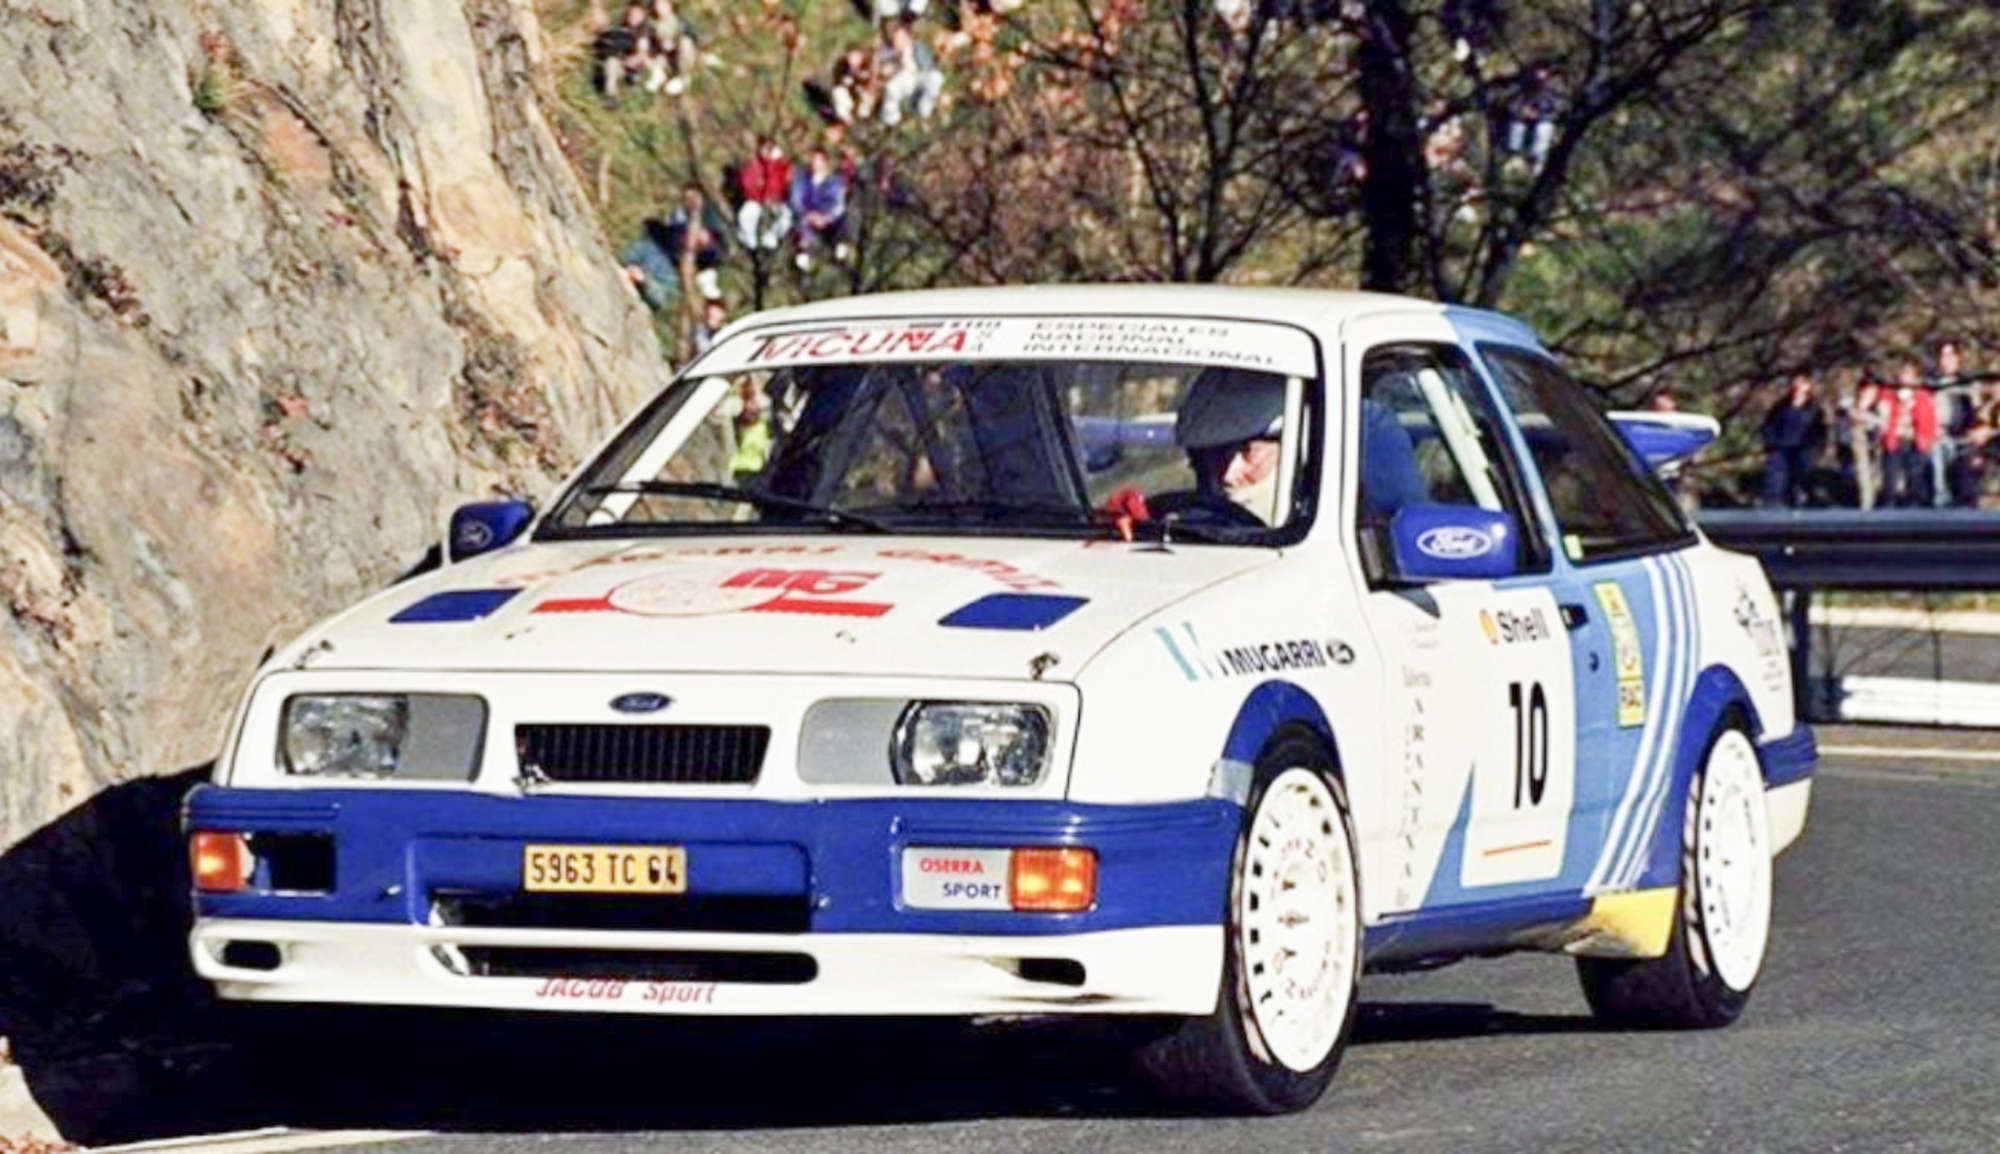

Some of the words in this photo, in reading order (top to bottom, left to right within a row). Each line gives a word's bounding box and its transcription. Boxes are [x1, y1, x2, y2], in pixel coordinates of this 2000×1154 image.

[1029, 332, 1185, 345] NACIONAL
[1023, 343, 1274, 365] INTERNACIONAL
[1496, 608, 1550, 643] Shell
[1508, 681, 1549, 809] 10
[532, 853, 596, 884] 5963
[606, 854, 636, 885] TC
[920, 858, 985, 874] OSERRA
[942, 882, 1002, 899] SPORT
[535, 976, 628, 999] JACOB
[642, 978, 717, 1004] Sport
